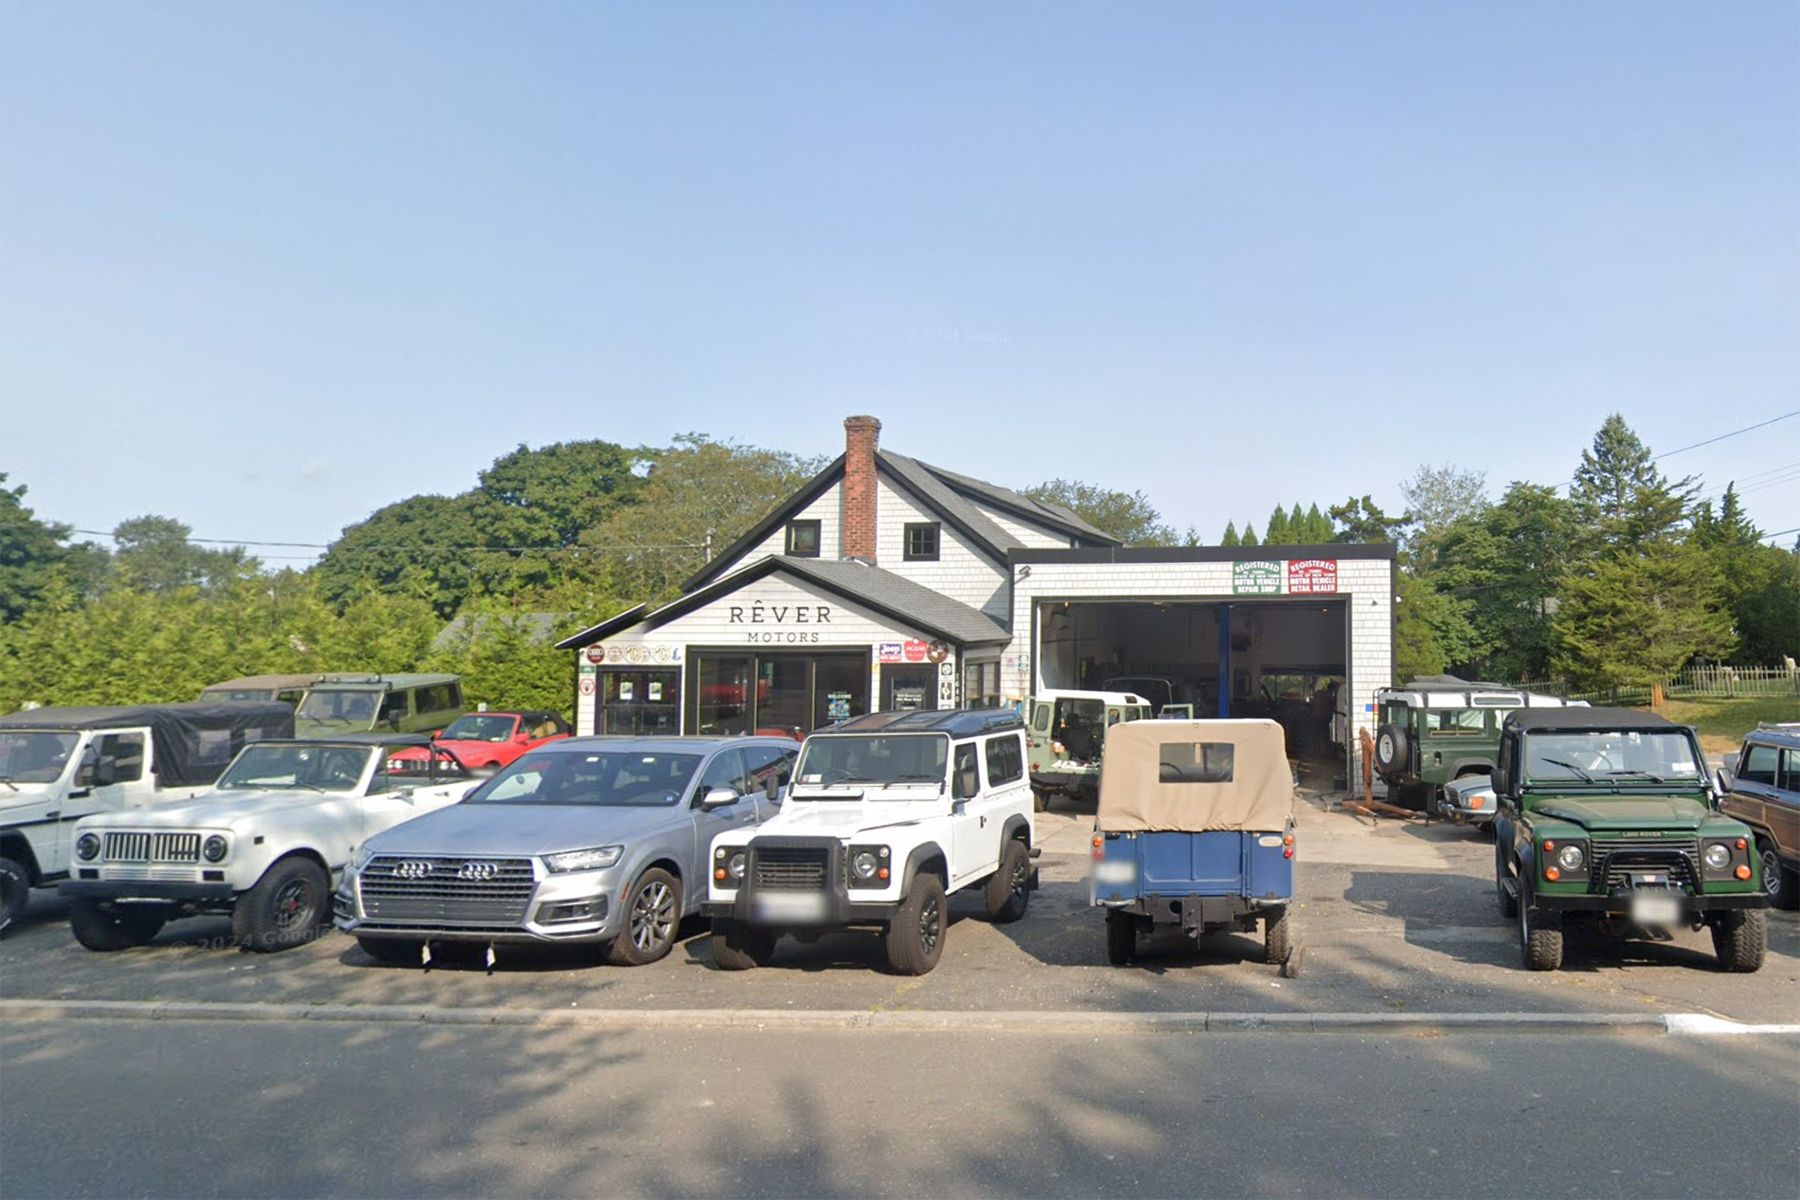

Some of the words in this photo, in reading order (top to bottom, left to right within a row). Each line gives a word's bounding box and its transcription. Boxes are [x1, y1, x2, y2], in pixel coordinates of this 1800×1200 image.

[1235, 561, 1280, 573] REGISTERED
[1290, 560, 1335, 573] REGISTERED
[1256, 578, 1280, 586] VEHICLE
[1312, 577, 1335, 585] VEHICLE
[1312, 584, 1335, 592] DEALER
[729, 599, 831, 623] RÊVER
[747, 632, 819, 643] MOTORS
[880, 645, 900, 655] Jeep
